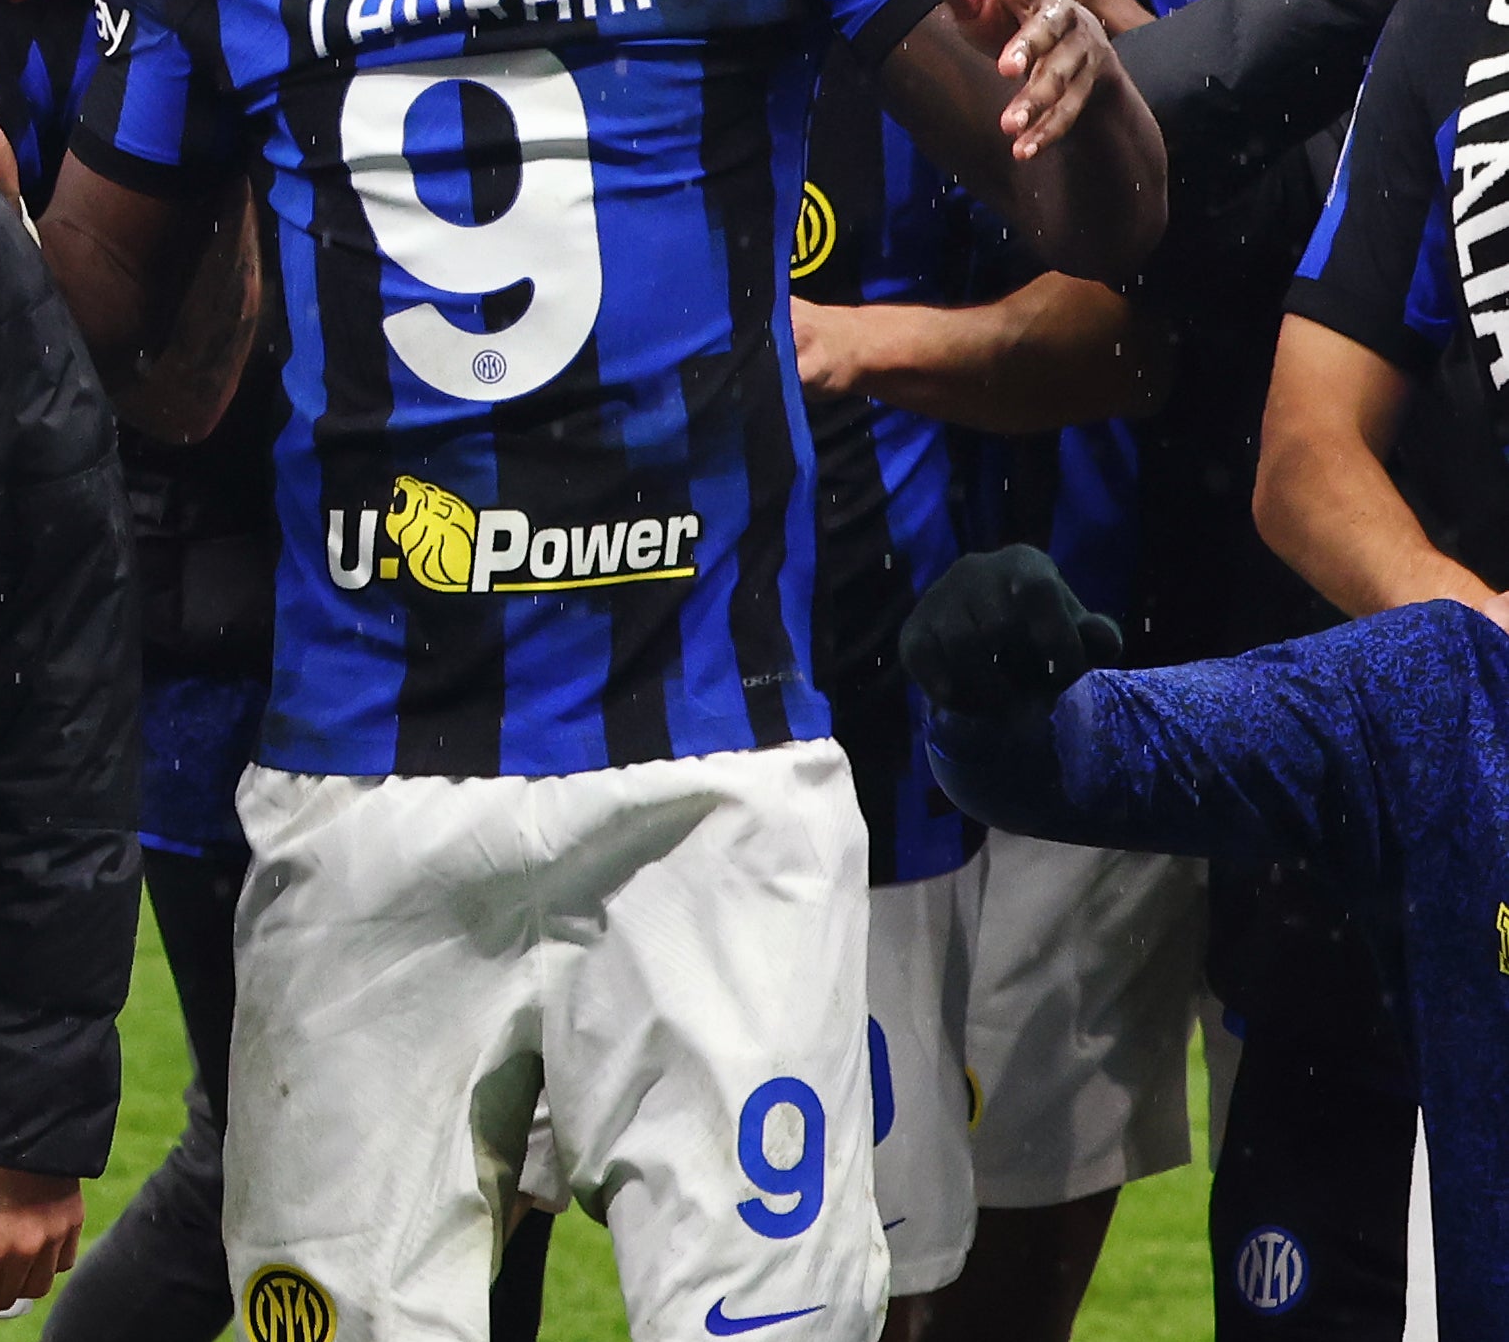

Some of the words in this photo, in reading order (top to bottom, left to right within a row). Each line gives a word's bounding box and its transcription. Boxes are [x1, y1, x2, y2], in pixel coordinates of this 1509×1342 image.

[337, 48, 603, 401] 9
[470, 508, 700, 594] Power
[736, 1076, 826, 1239] 9
